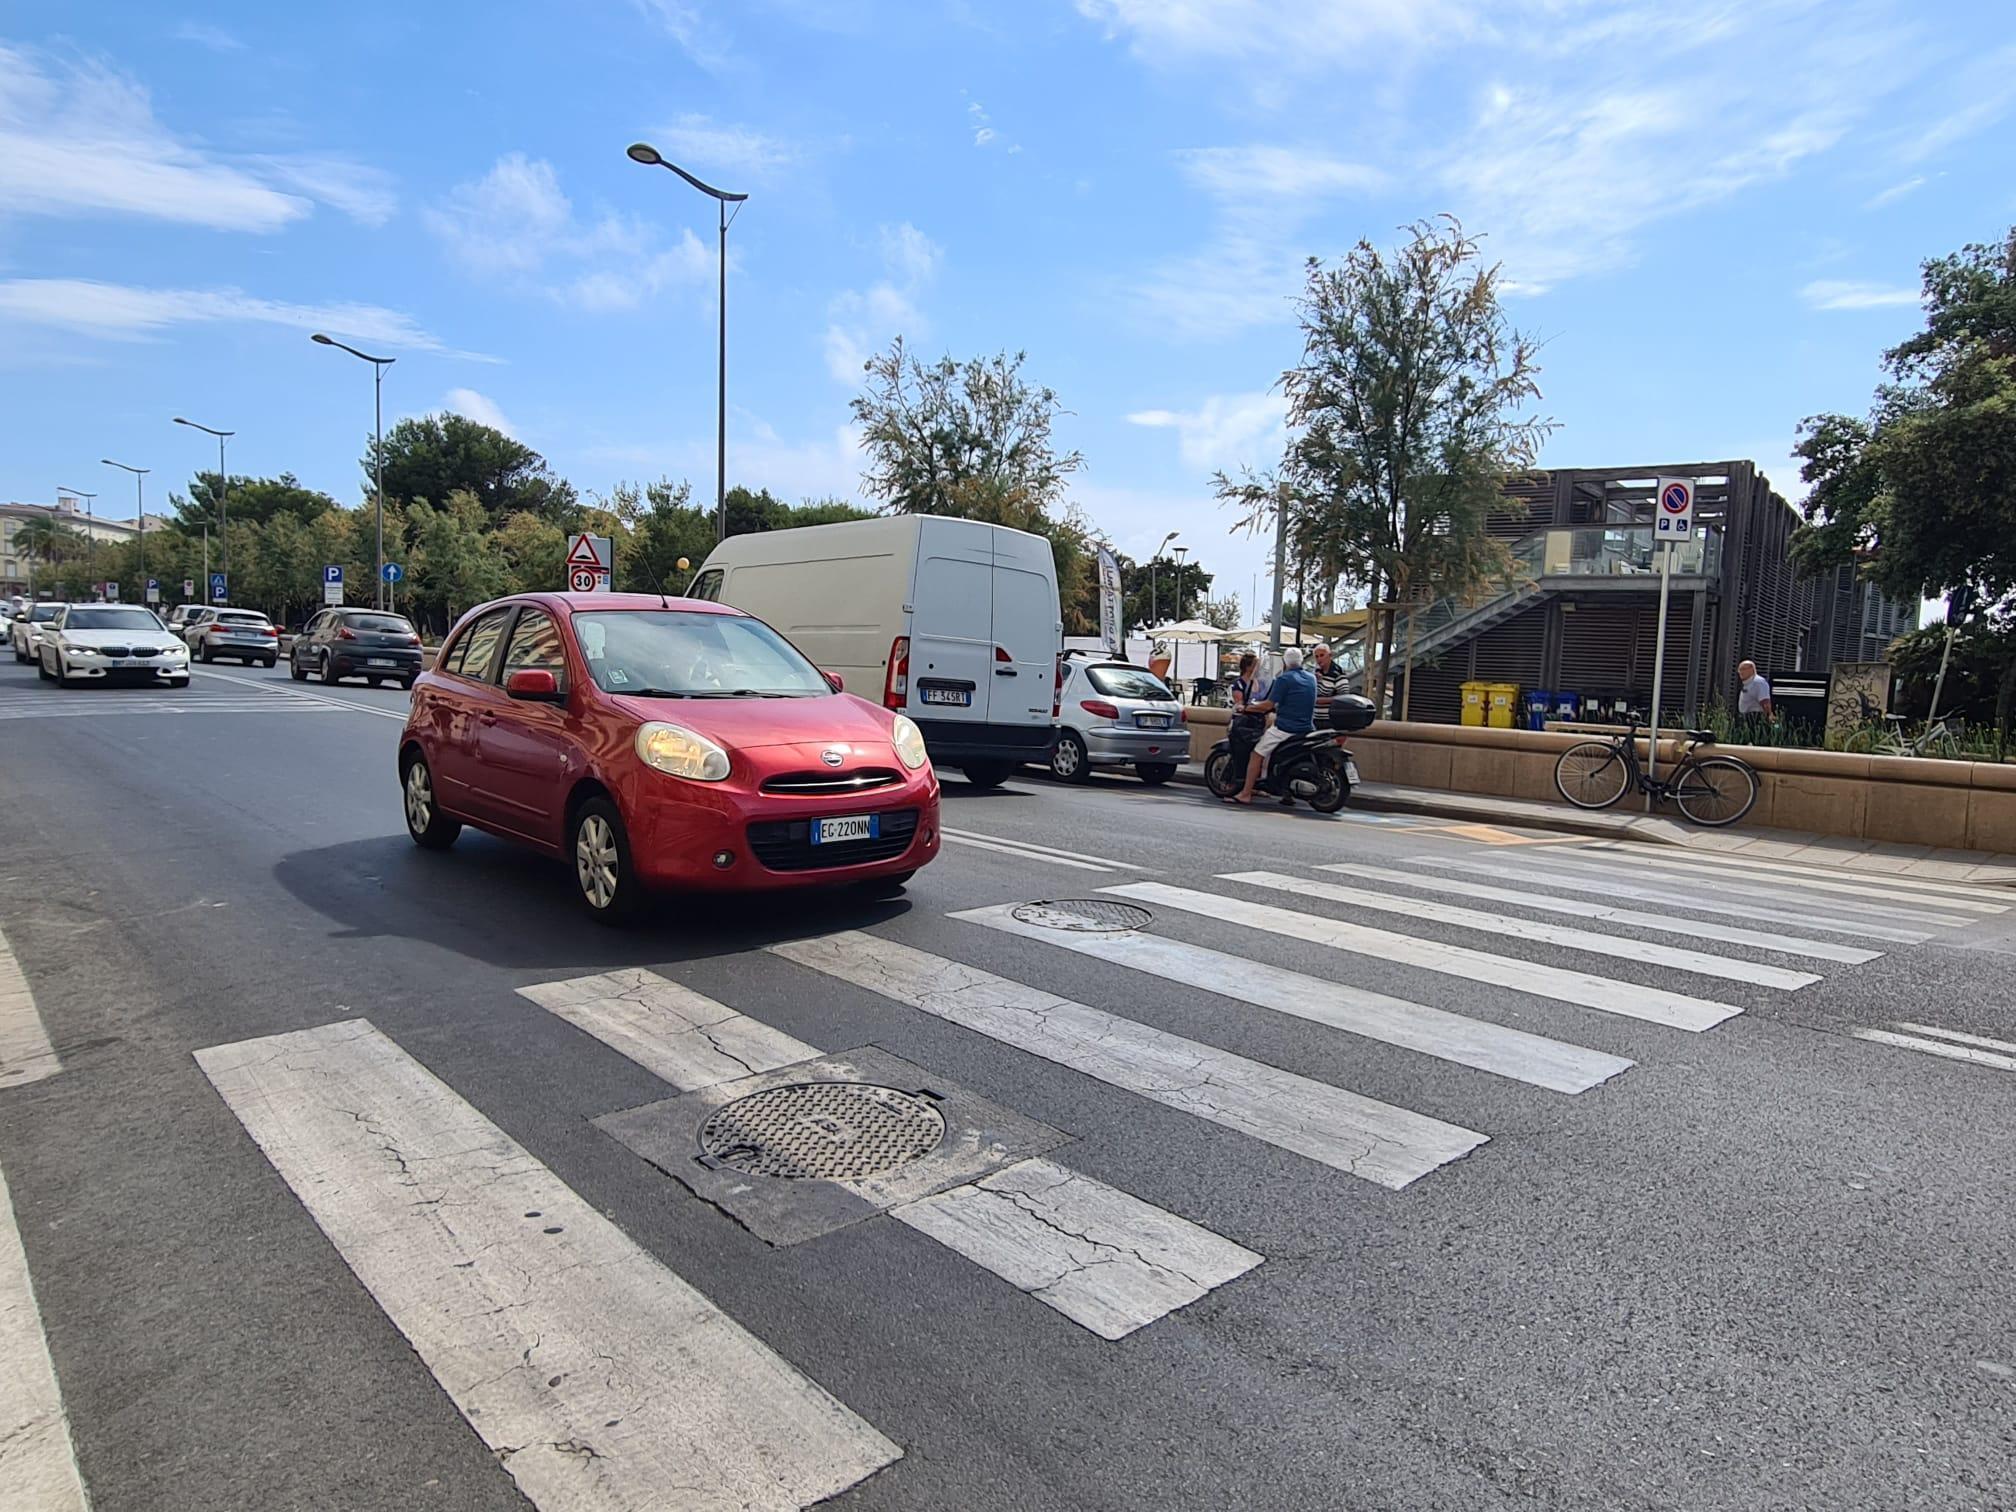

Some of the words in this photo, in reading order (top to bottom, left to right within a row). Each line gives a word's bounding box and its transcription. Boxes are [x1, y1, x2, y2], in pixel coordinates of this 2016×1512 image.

[1661, 520, 1668, 529] P
[328, 567, 339, 580] P
[148, 579, 157, 588] P
[576, 576, 590, 587] 30
[215, 586, 225, 597] P
